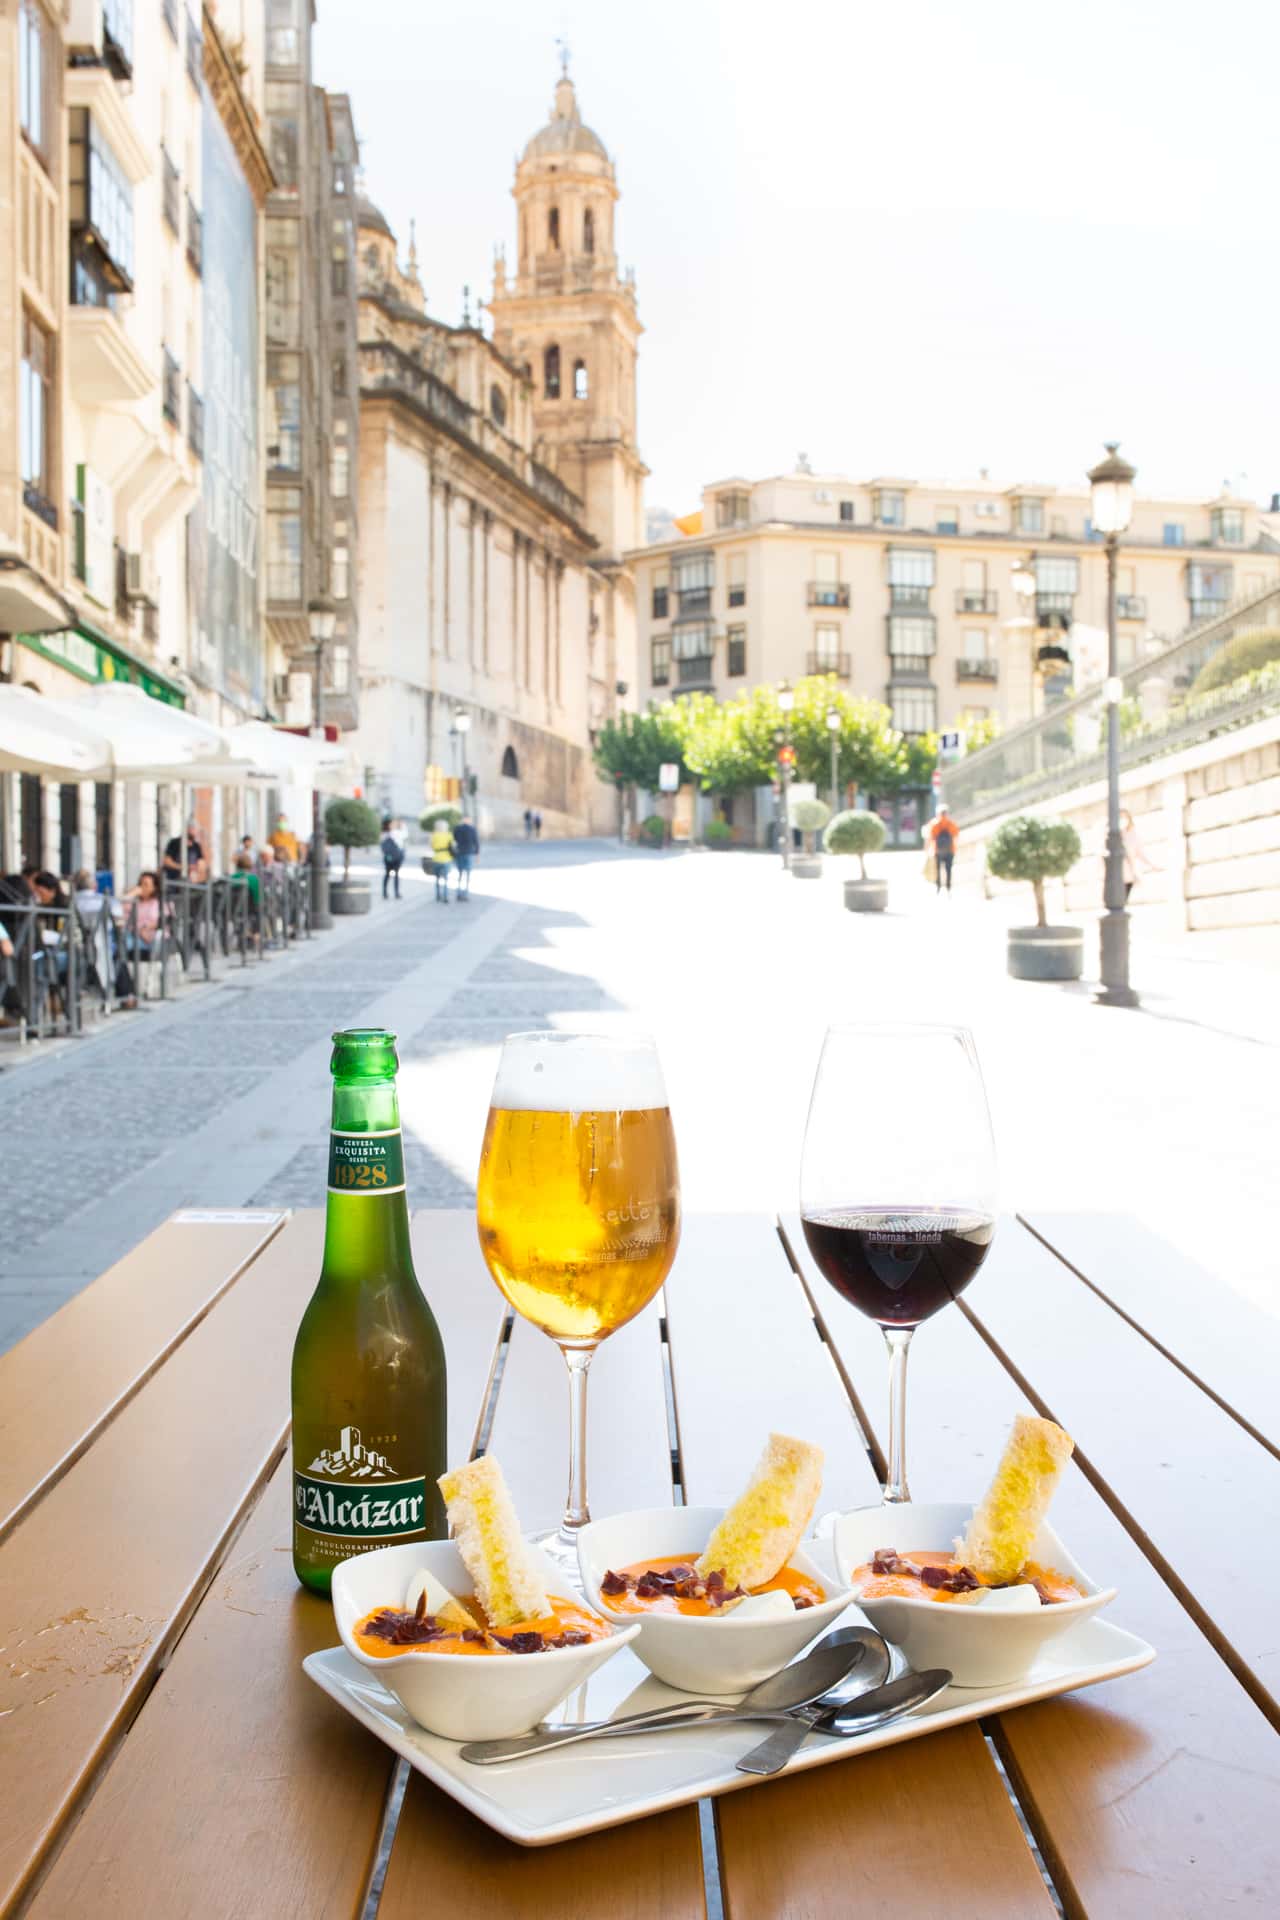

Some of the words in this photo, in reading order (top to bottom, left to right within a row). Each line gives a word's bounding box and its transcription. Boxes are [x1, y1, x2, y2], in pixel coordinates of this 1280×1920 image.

[335, 1147, 387, 1156] EXQUISITA
[335, 1165, 388, 1186] 1928
[868, 1232, 906, 1241] tabernas
[915, 1232, 942, 1241] tienda
[304, 1487, 424, 1528] Alcázar
